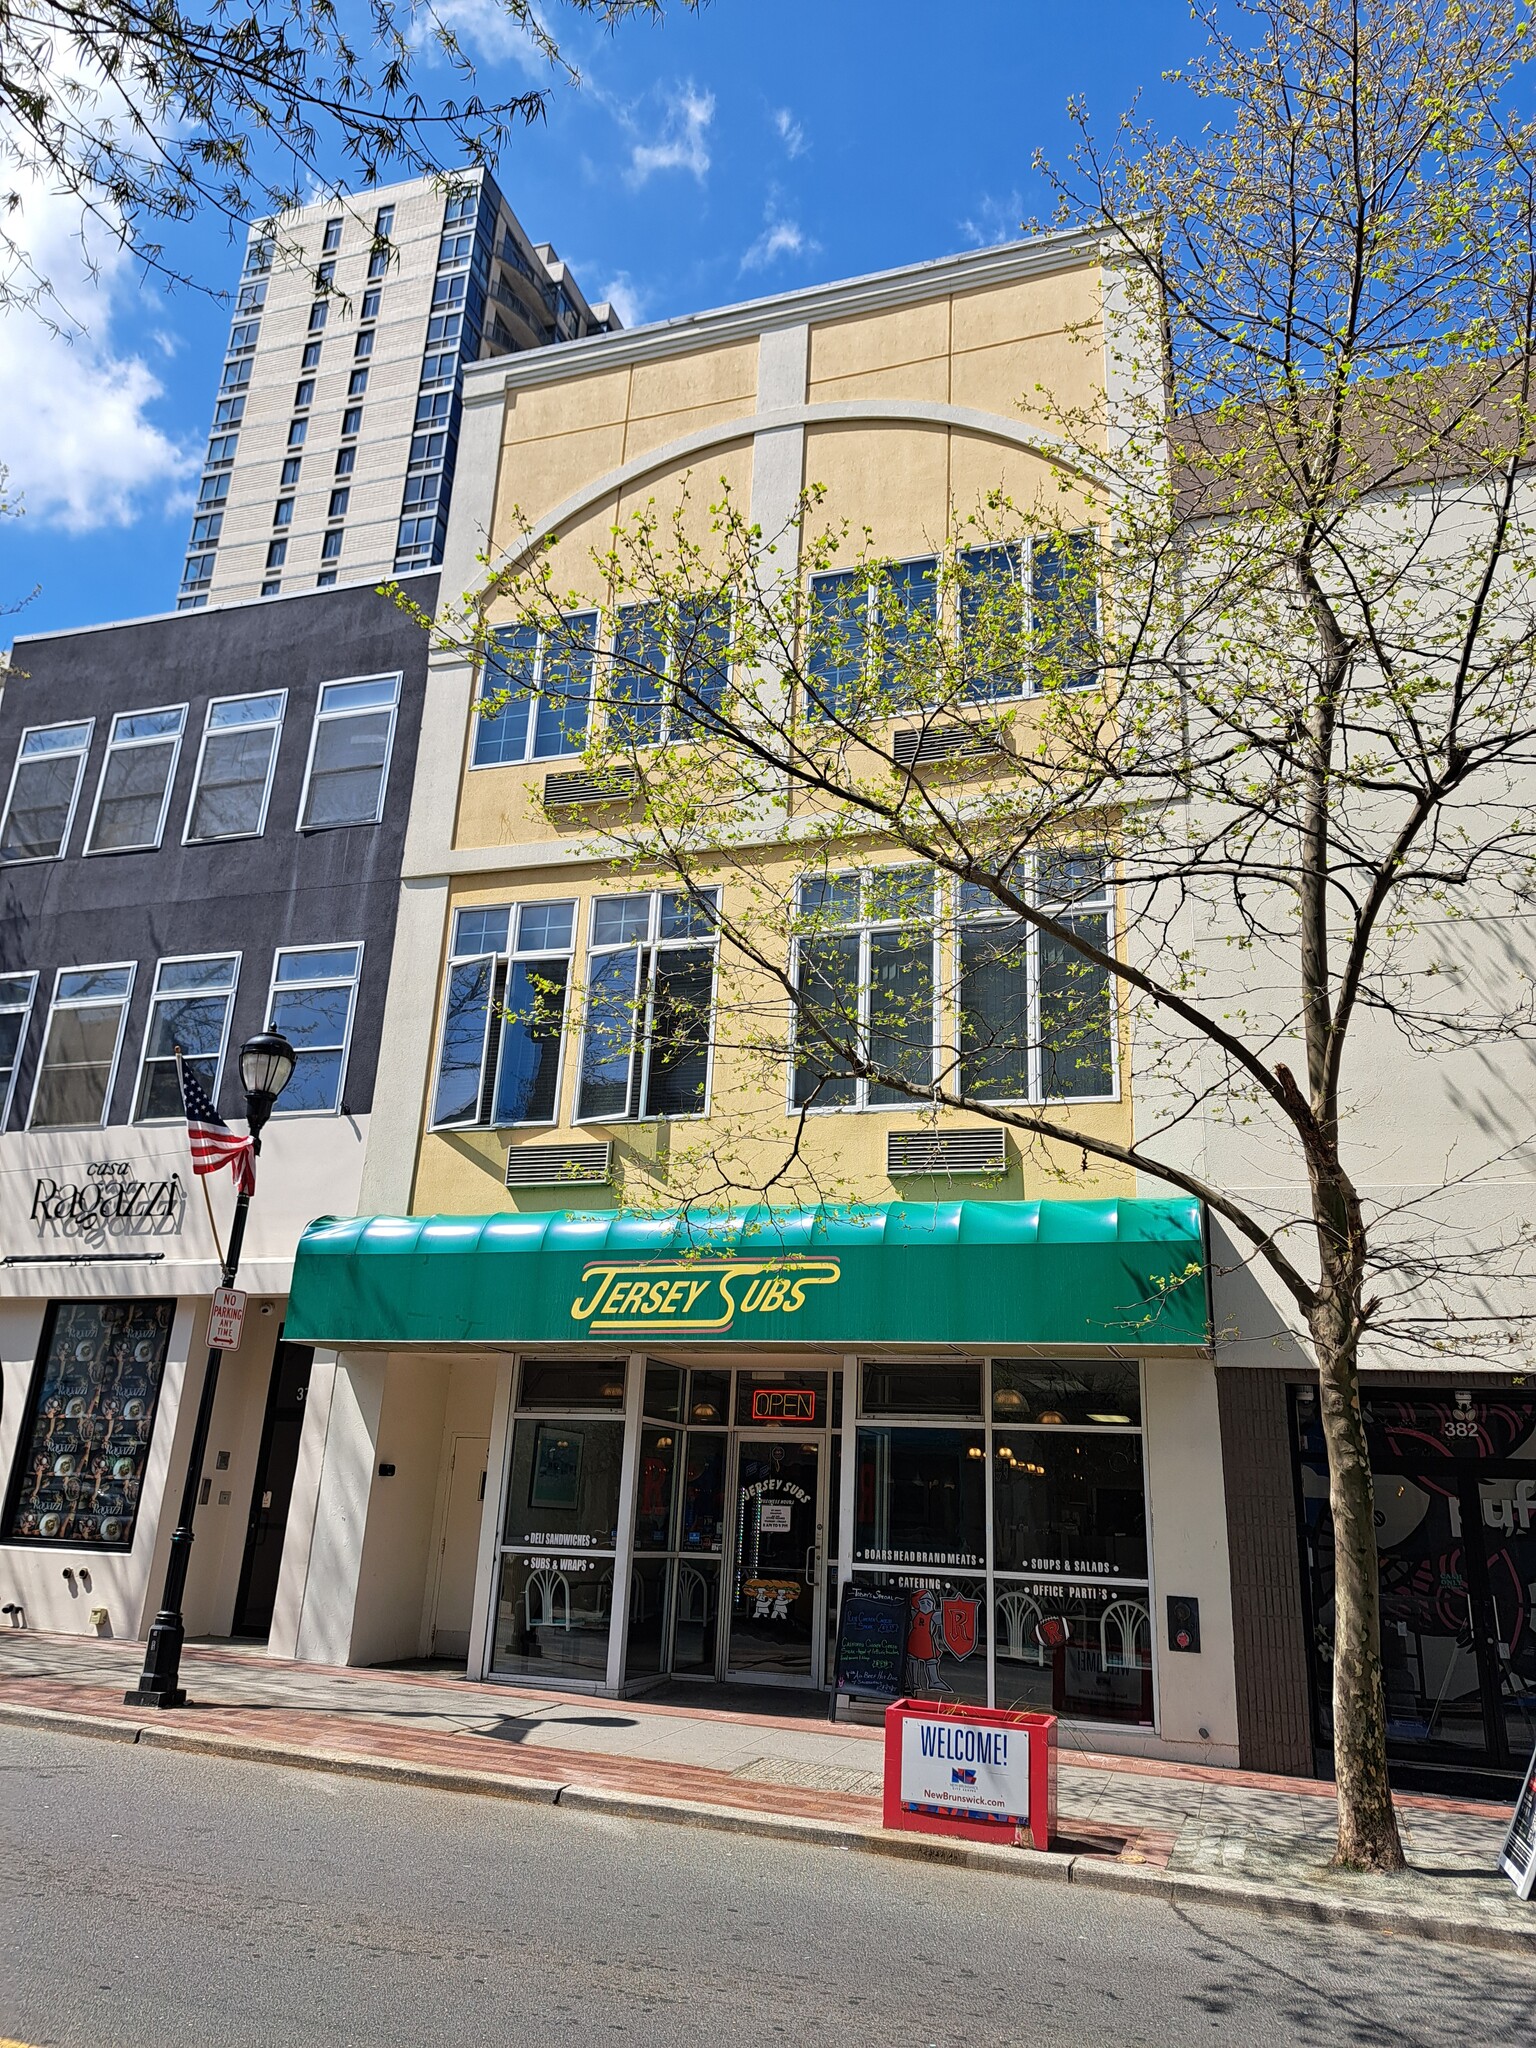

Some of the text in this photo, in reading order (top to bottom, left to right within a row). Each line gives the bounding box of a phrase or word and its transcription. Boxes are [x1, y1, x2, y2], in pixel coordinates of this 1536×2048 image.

[86, 1162, 130, 1176] casa
[30, 1172, 178, 1231] Ragazzi
[223, 1293, 237, 1306] NO
[570, 1262, 841, 1327] JERSEY SUBS
[213, 1305, 243, 1320] PARKING
[218, 1319, 234, 1328] ANY
[217, 1327, 233, 1337] TIME
[755, 1392, 813, 1417] OPEN
[1444, 1422, 1479, 1437] 382
[744, 1478, 812, 1504] JERSEY SUBS
[530, 1532, 591, 1547] DELI SANDWICHES
[530, 1557, 587, 1571] SUBS & WRAPS
[1031, 1558, 1110, 1573] SOUPS & SALADS
[898, 1576, 941, 1590] CATERING
[1033, 1584, 1064, 1597] OFFICE
[948, 1609, 973, 1642] R
[1042, 1619, 1063, 1645] R
[920, 1725, 1008, 1766] WELCOME!
[923, 1789, 1005, 1808] NewBrunswick.com
